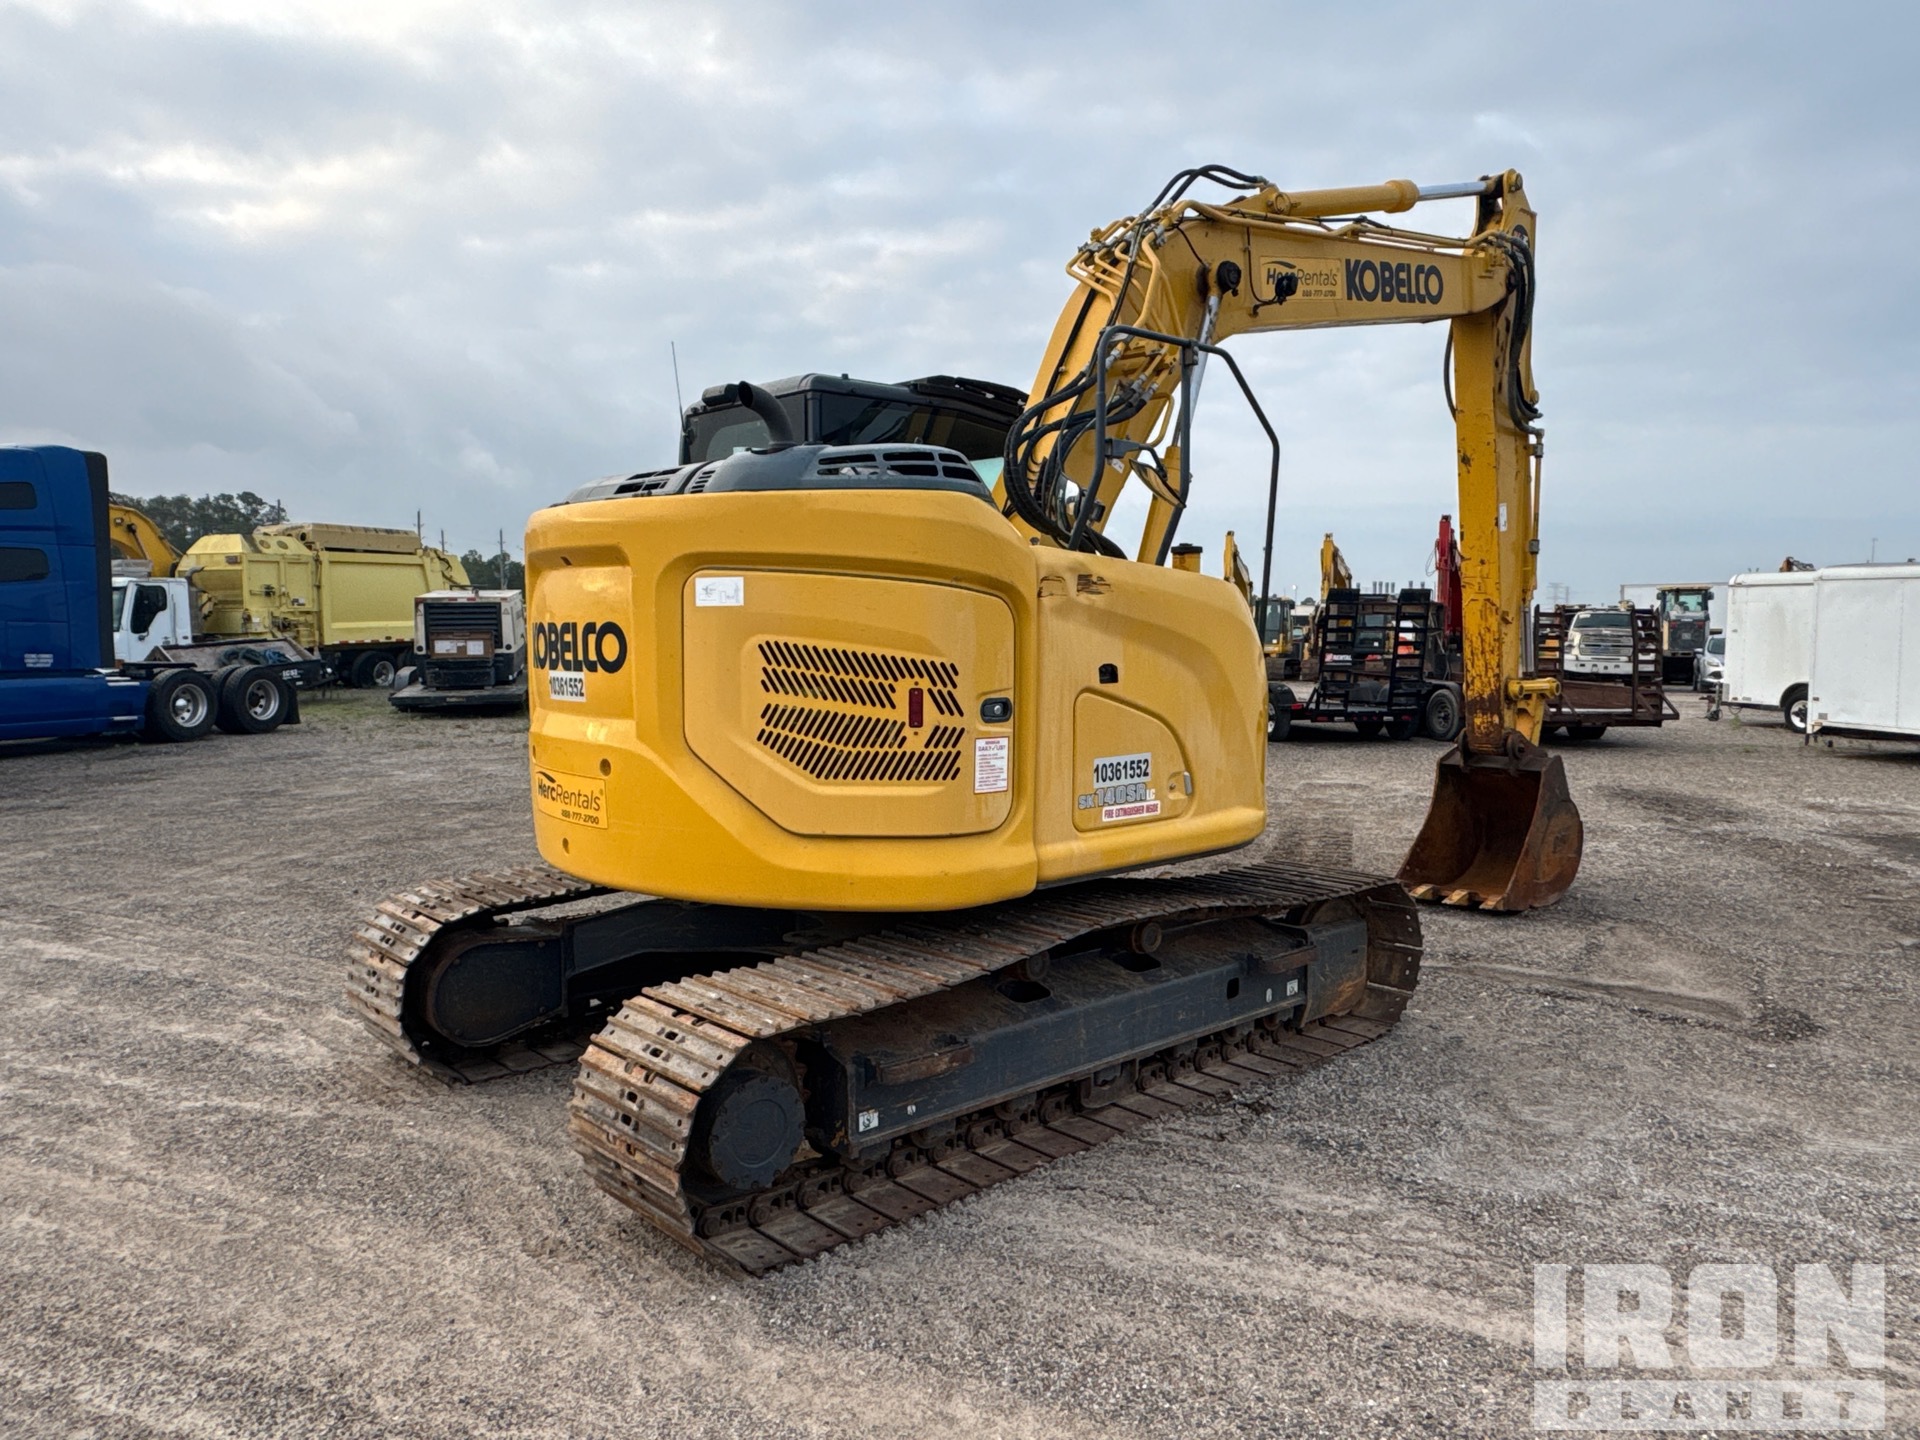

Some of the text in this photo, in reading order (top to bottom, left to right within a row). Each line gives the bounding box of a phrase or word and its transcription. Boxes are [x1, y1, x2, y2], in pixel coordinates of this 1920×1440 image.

[1345, 258, 1444, 305] KOBELCO
[532, 621, 627, 674] KOBELCO
[549, 676, 584, 697] 10361552
[1093, 758, 1150, 783] 10361552
[1104, 803, 1159, 818] FIRE EXTINGUISHER INSIDE
